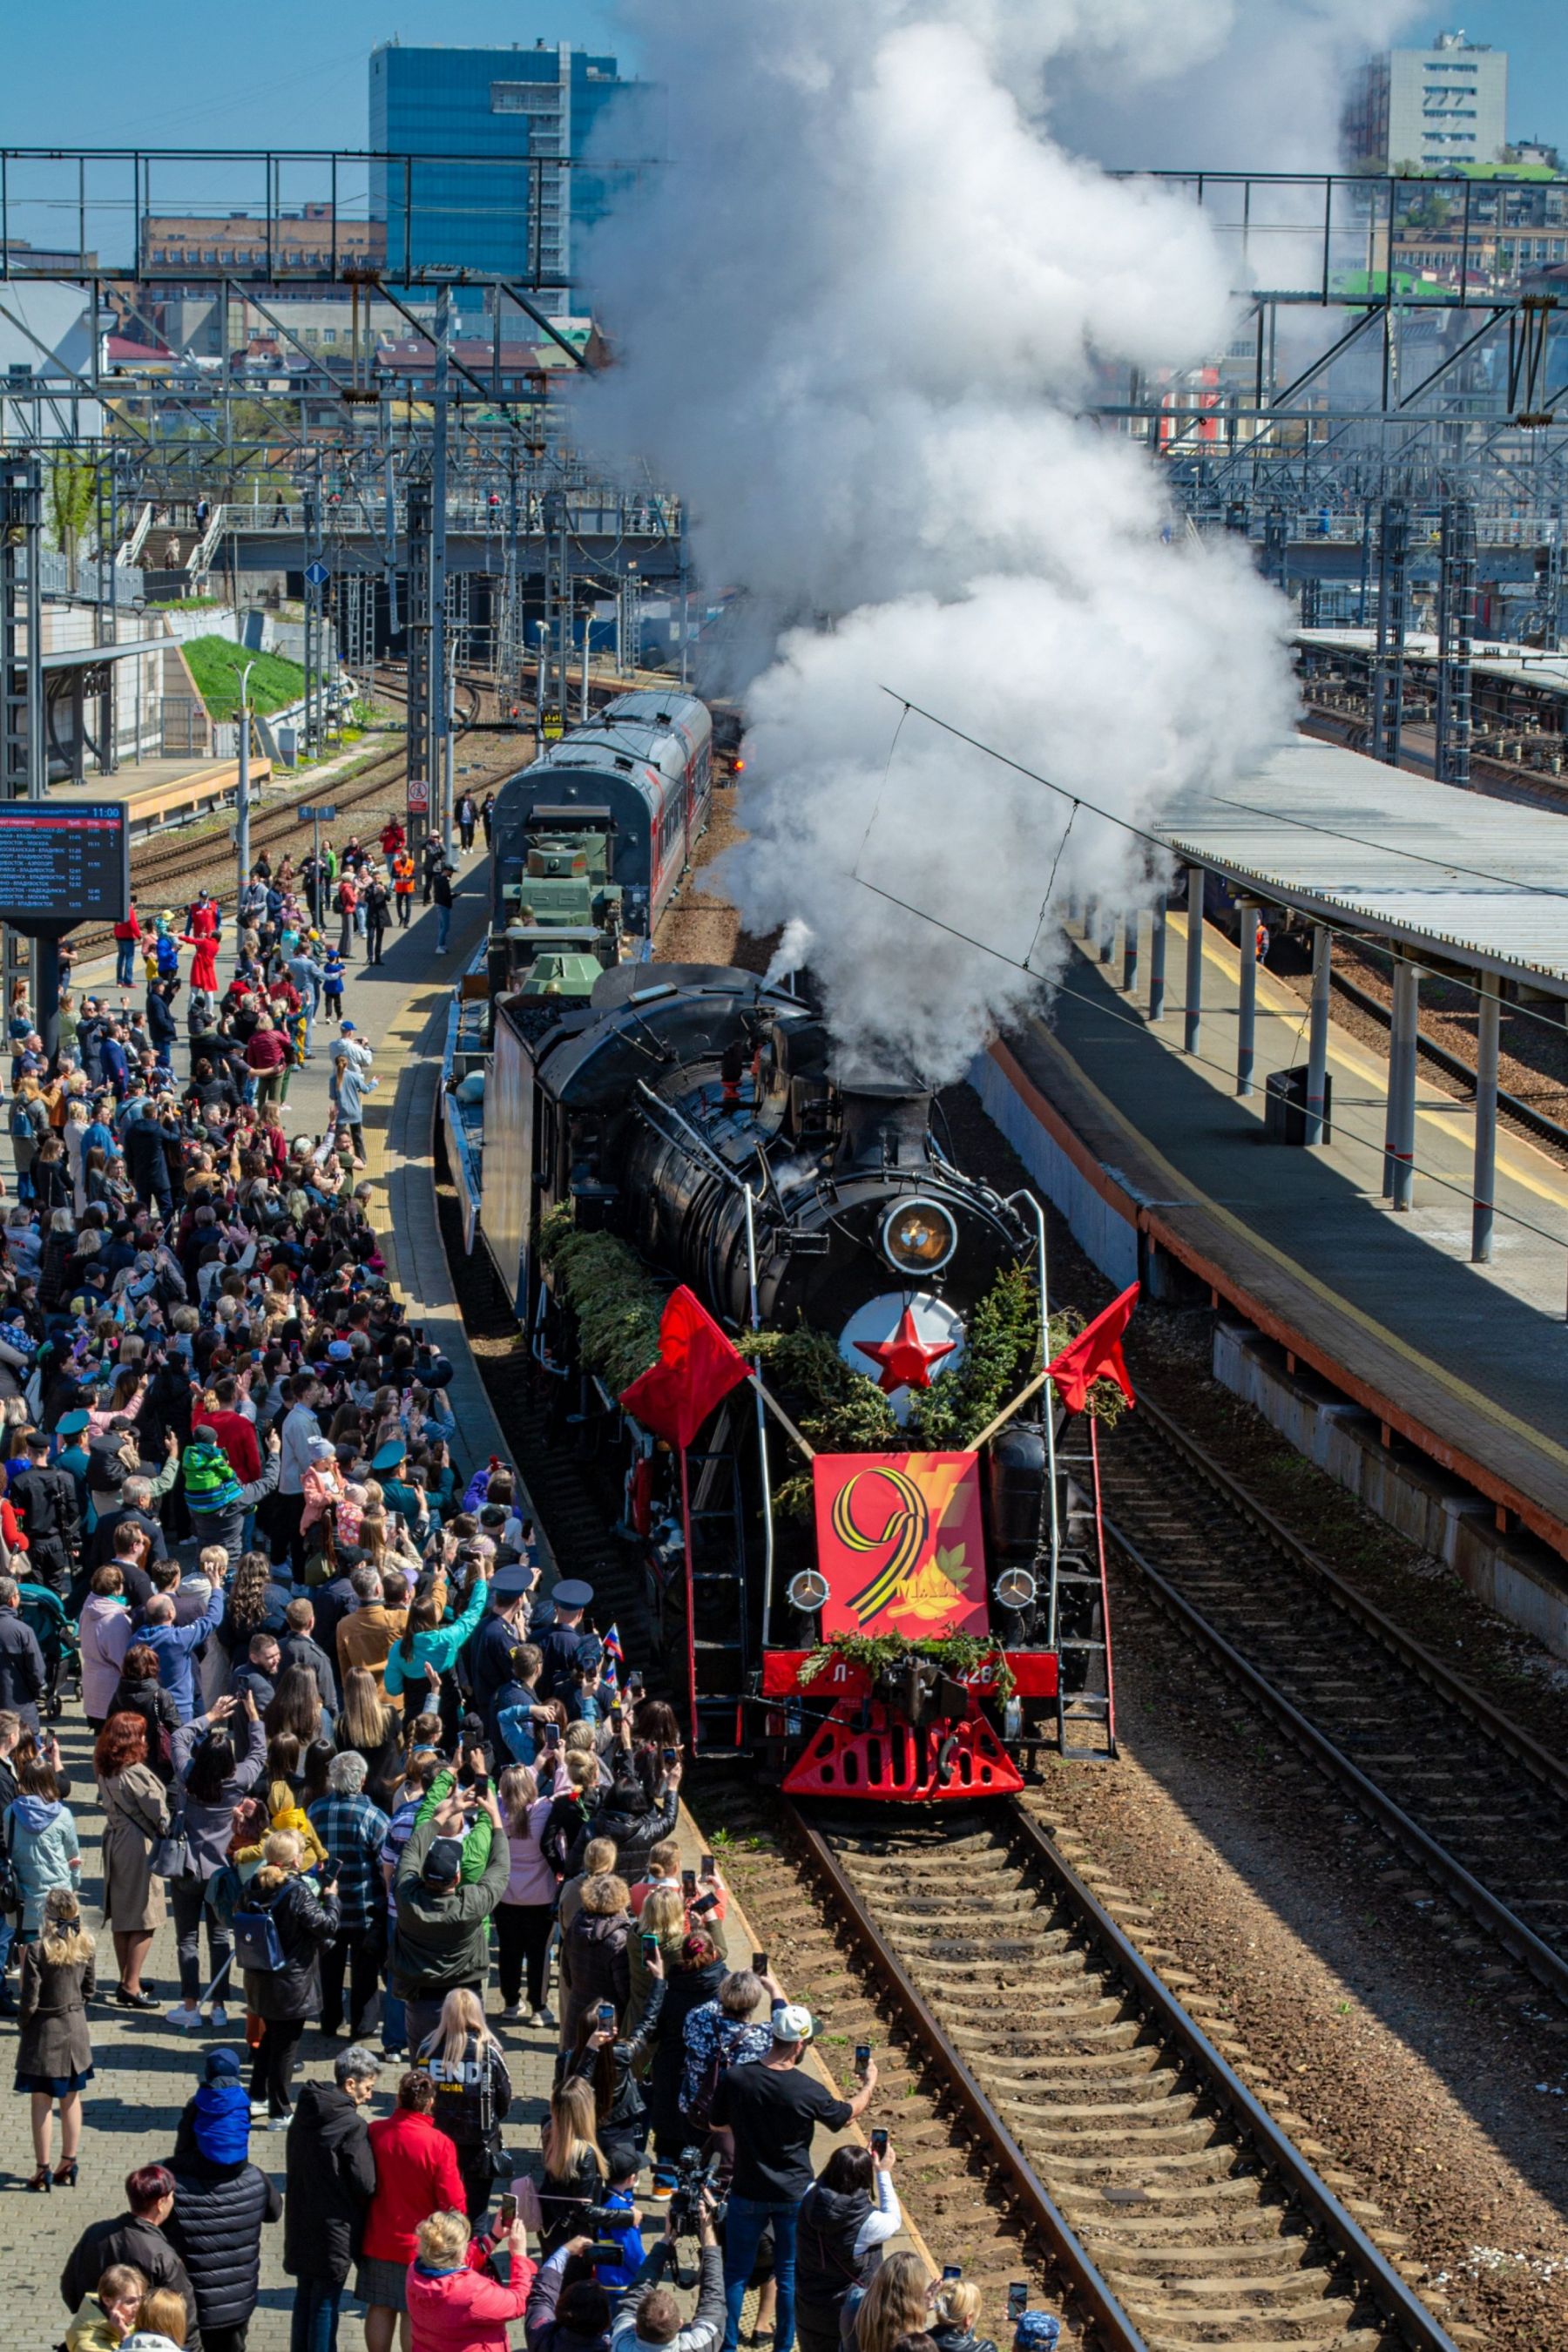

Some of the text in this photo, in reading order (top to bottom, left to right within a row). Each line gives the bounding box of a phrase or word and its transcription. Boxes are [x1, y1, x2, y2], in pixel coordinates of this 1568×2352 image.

[93, 808, 119, 817] 11:00
[831, 1466, 929, 1627] 9
[439, 2083, 463, 2092] ROMA
